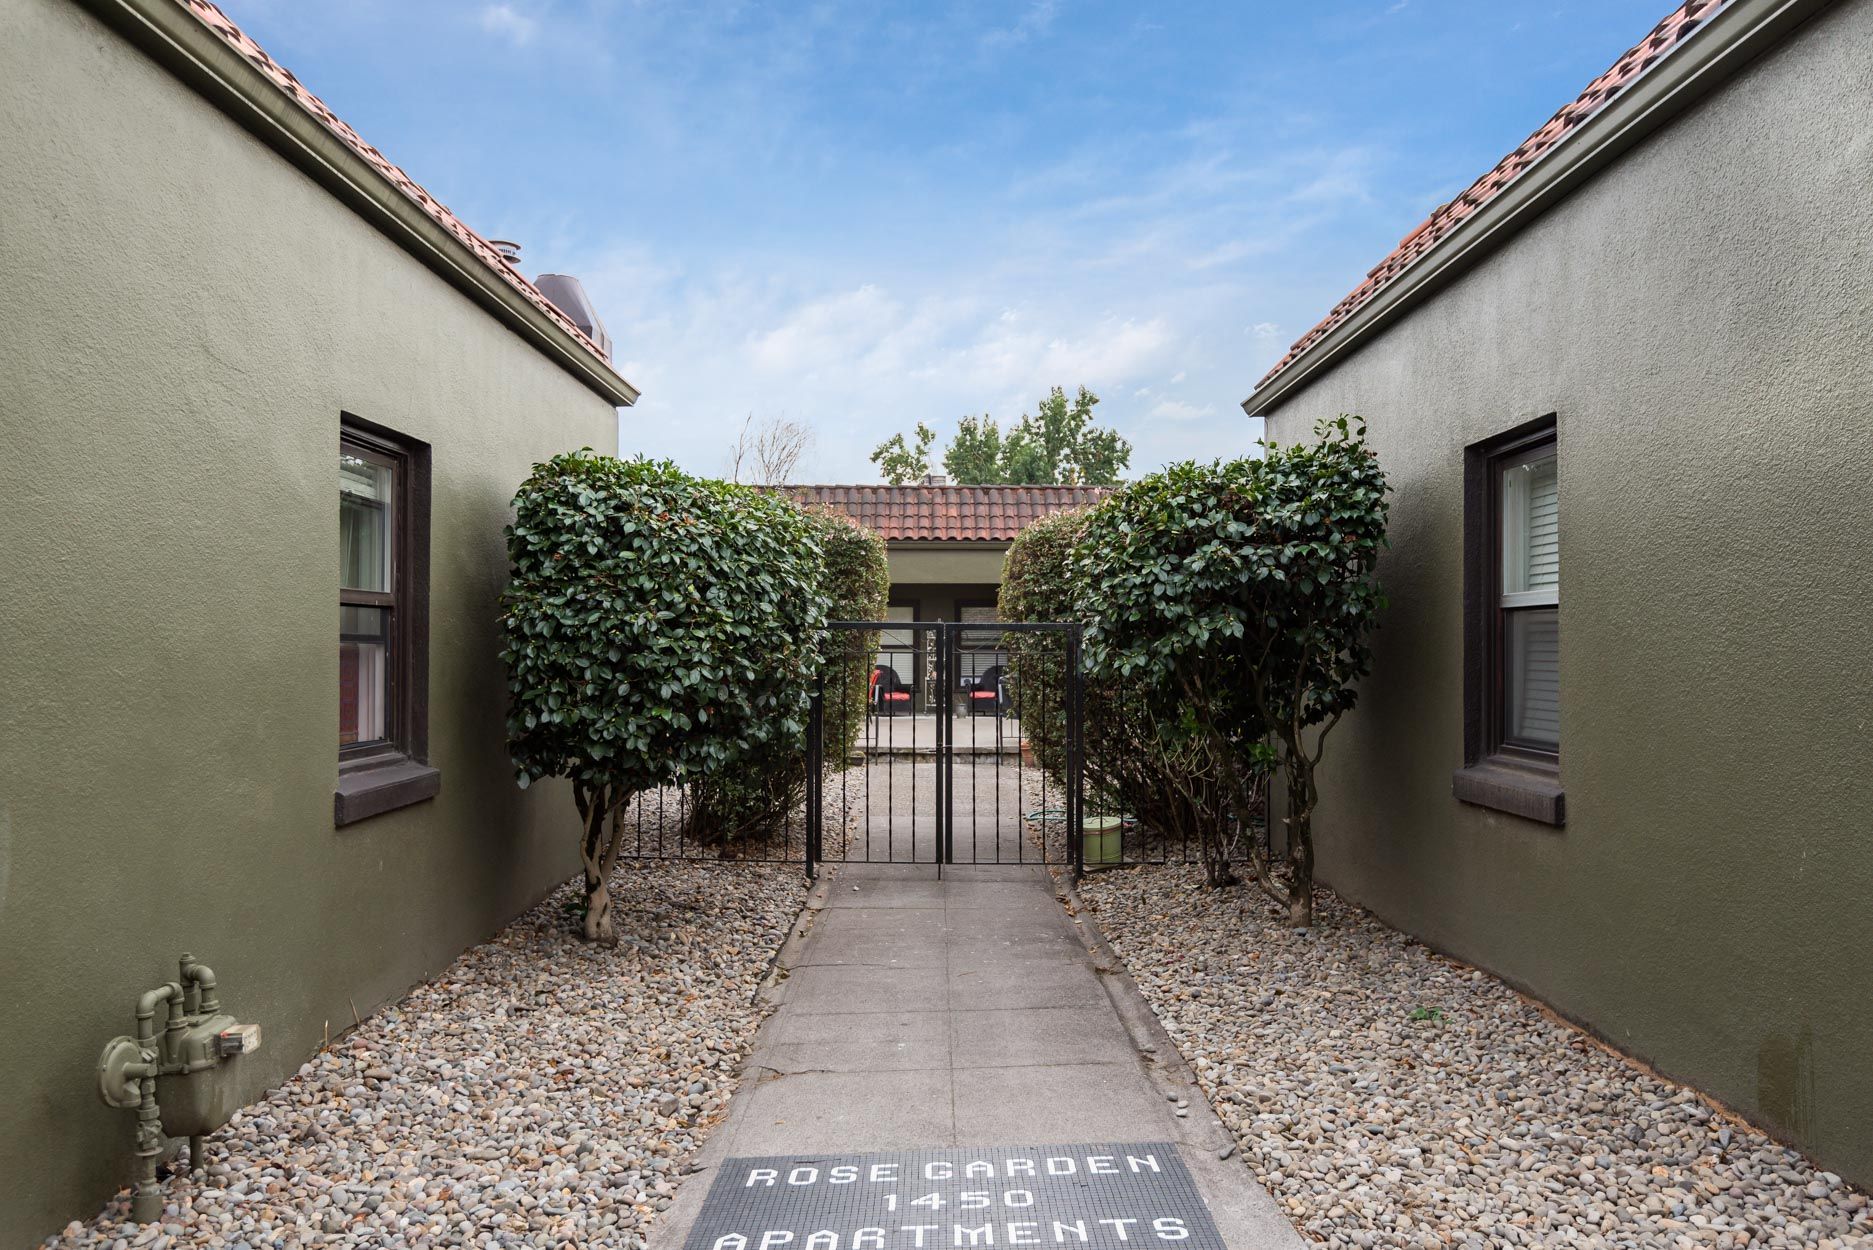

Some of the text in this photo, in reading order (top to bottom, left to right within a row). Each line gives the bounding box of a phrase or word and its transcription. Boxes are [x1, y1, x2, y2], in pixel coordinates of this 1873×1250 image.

[745, 1154, 1161, 1188] ROSE GARDEN
[881, 1188, 1035, 1212] 1450
[712, 1217, 1190, 1250] APARTMENTS
